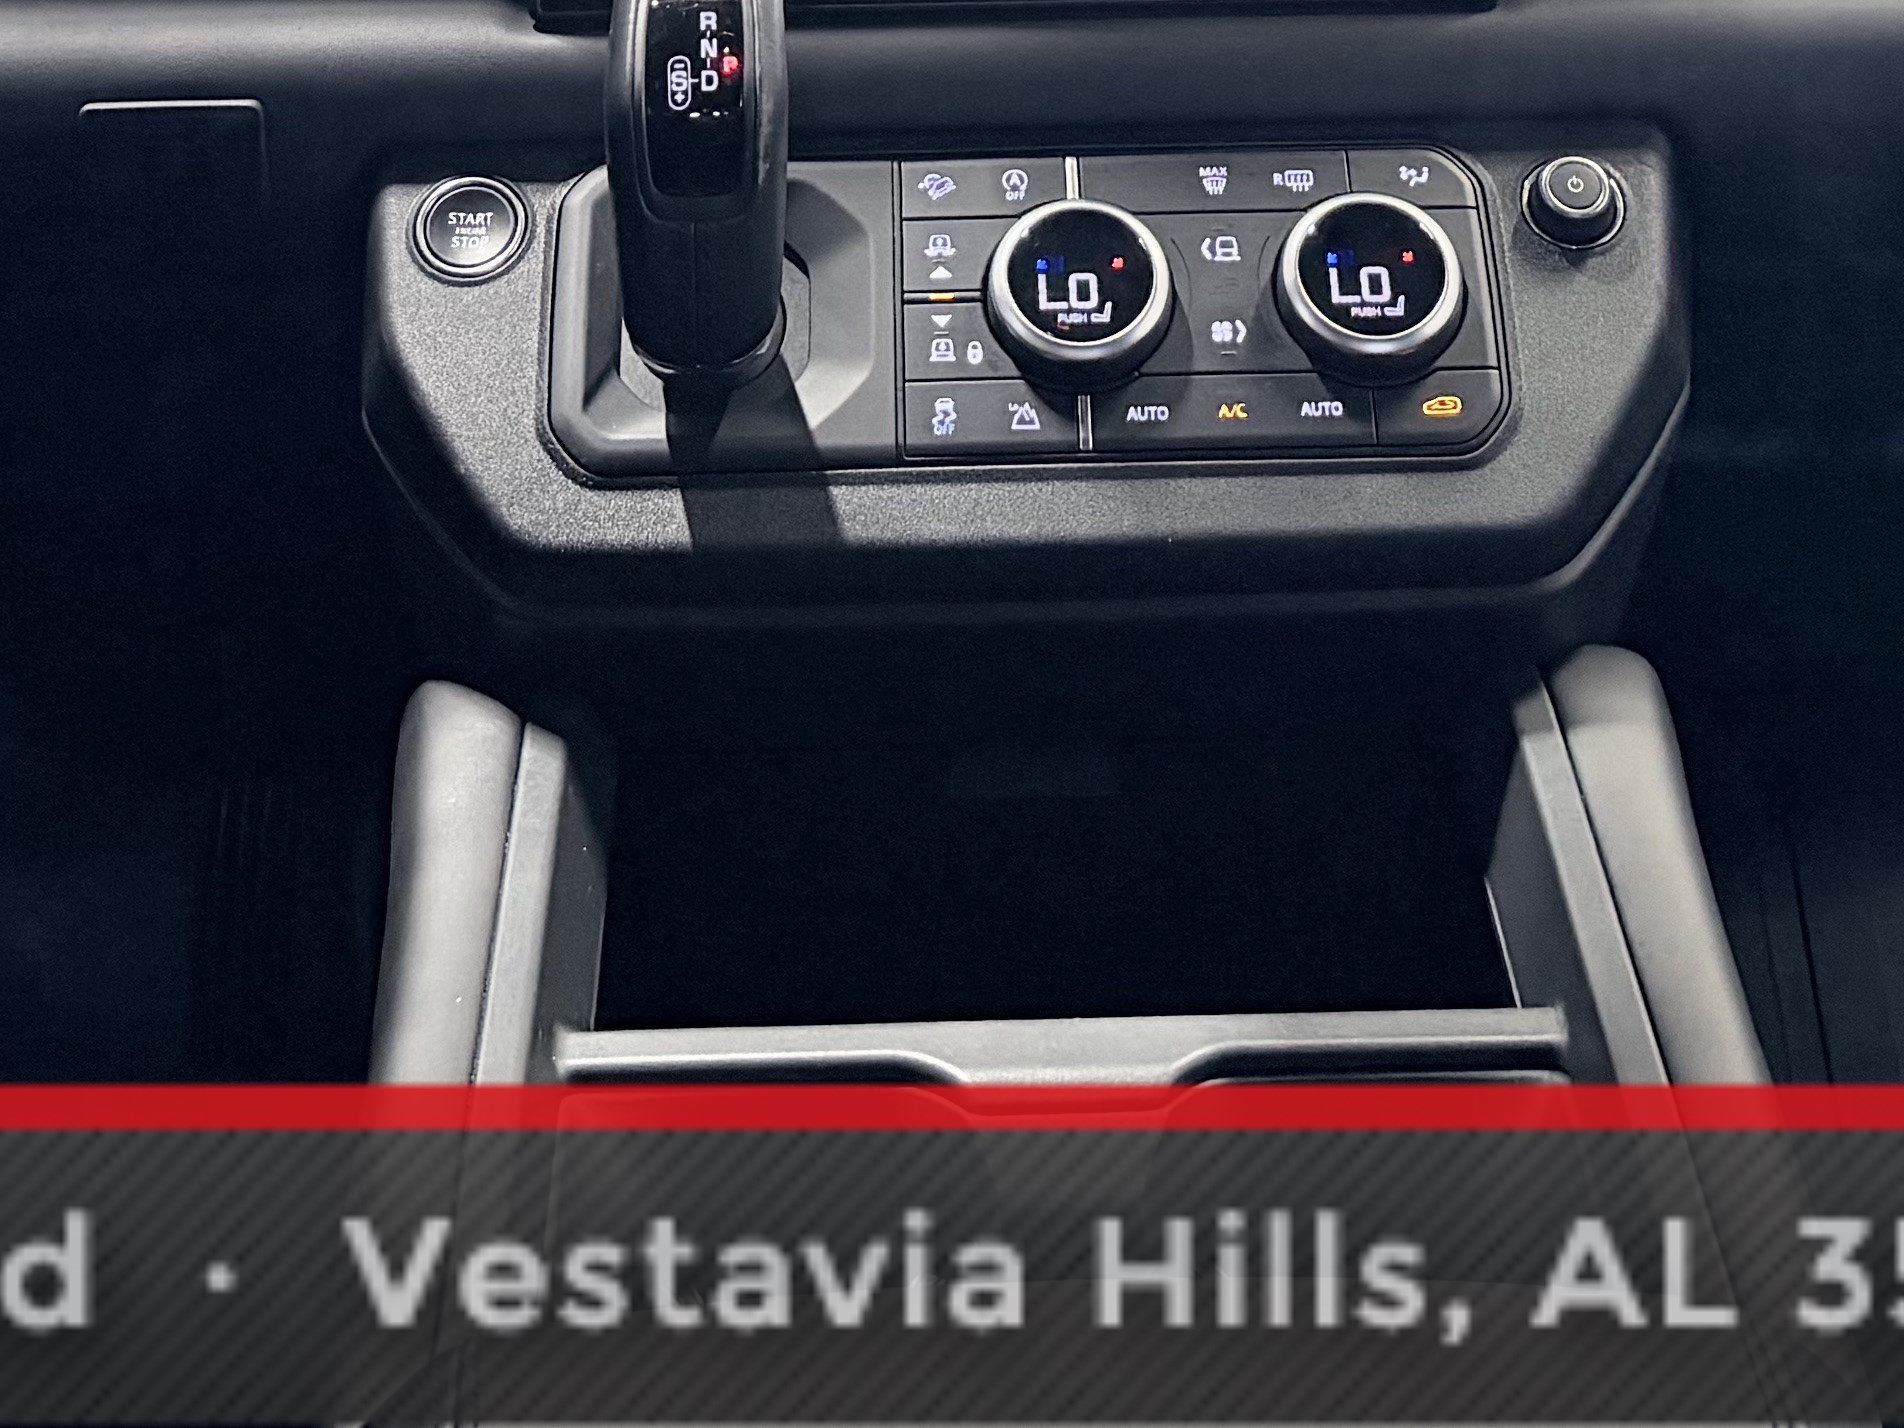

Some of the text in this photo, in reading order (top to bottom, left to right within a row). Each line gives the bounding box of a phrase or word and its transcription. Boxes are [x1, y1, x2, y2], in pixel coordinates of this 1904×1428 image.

[700, 11, 717, 30] R
[700, 38, 718, 58] N
[701, 70, 719, 92] D
[1199, 167, 1227, 177] MAX
[448, 212, 494, 226] START
[451, 236, 490, 249] STOP
[1126, 405, 1169, 421] AUTO
[1218, 402, 1248, 419] A/C
[1301, 401, 1343, 417] AUTO
